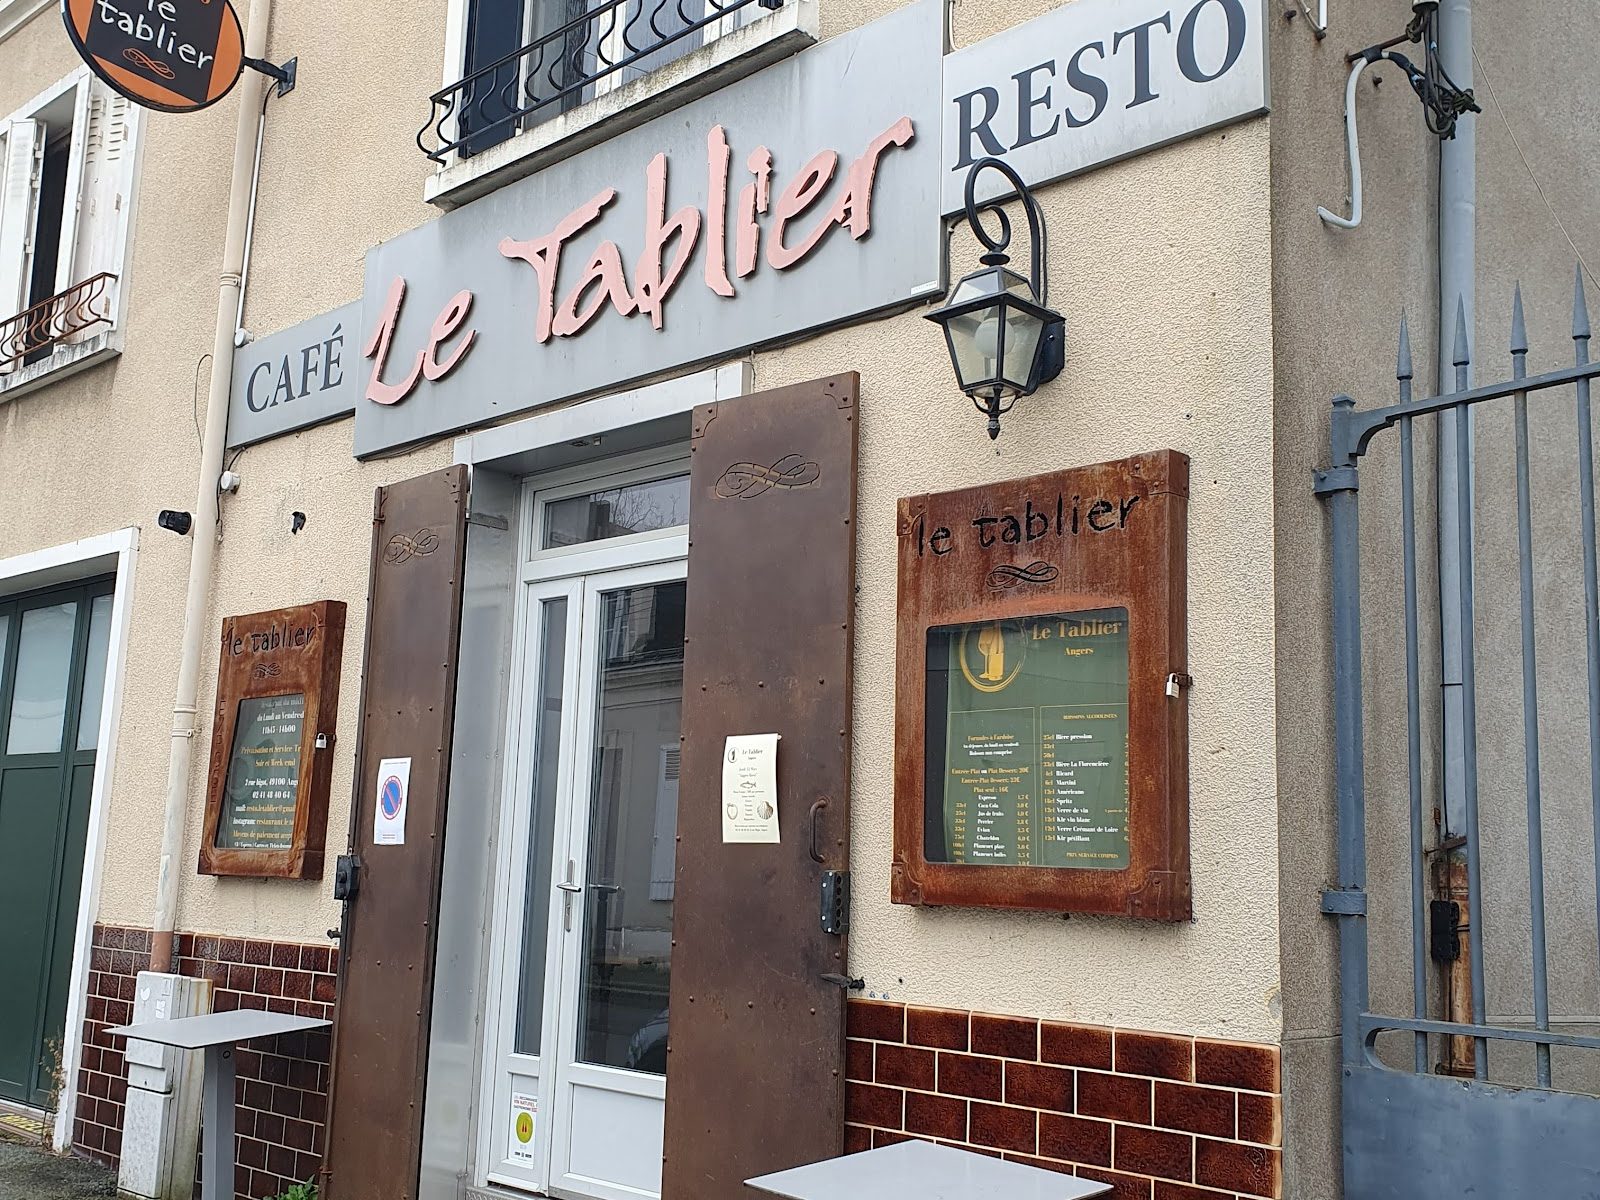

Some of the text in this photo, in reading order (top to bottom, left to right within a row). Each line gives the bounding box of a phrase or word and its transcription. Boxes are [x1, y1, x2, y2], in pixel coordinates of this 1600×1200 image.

[97, 0, 213, 69] tablier
[951, 0, 1246, 171] RESTO
[363, 115, 915, 407] Le Tablier
[246, 322, 344, 413] CAFÉ
[917, 492, 1140, 557] le tablier
[227, 622, 315, 656] le tablier
[1032, 619, 1122, 640] Le Tablier
[1064, 647, 1094, 657] Angers
